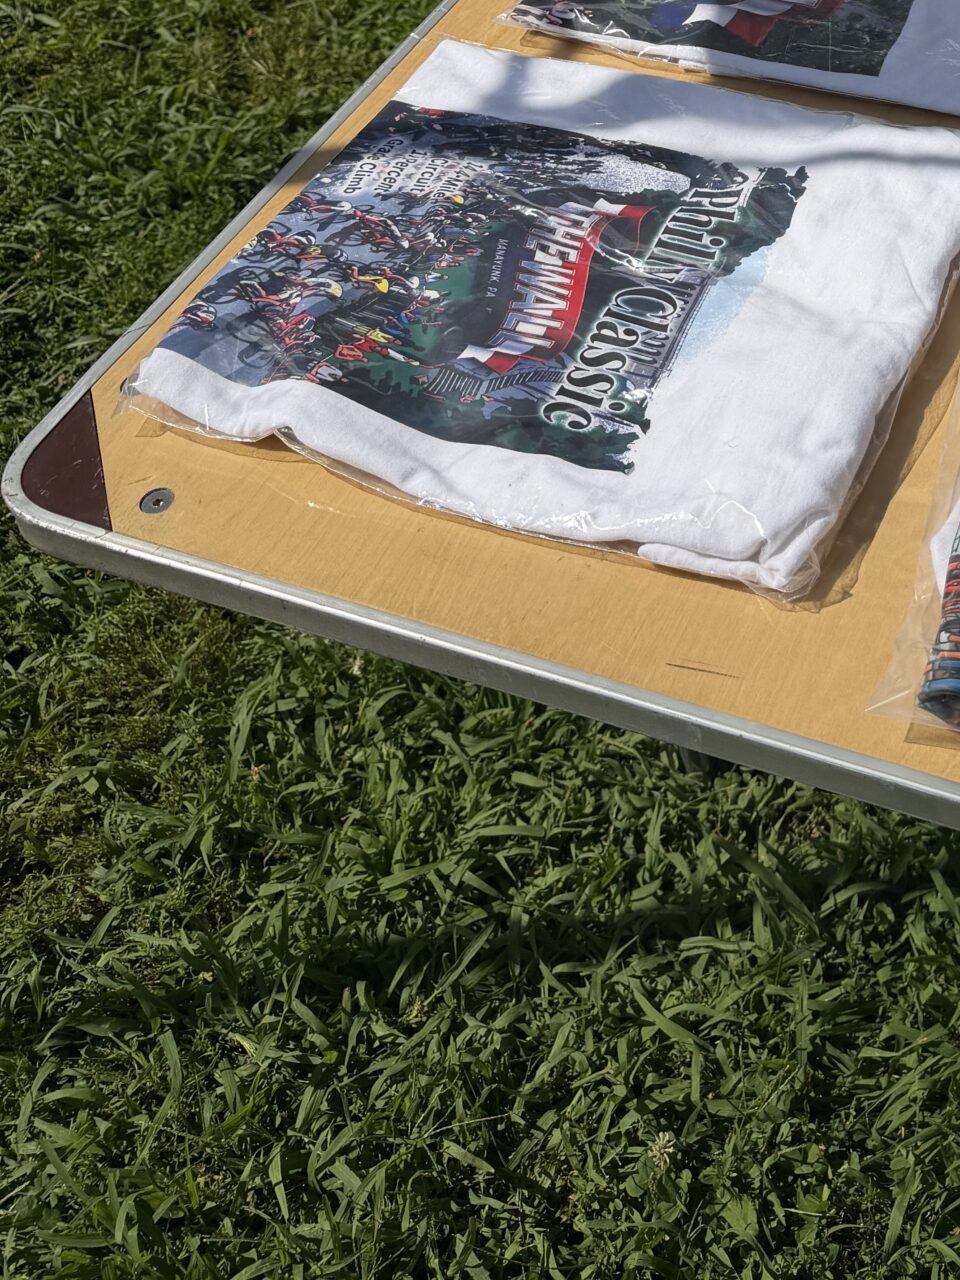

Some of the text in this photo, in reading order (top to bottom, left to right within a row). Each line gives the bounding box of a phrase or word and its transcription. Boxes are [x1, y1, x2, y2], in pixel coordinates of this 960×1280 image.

[343, 162, 377, 194] Climb
[374, 158, 418, 193] Percent
[410, 158, 449, 193] Circuit
[485, 238, 509, 298] MANAYUNK, PA
[488, 213, 599, 349] THE WALL
[543, 187, 744, 430] Philly Classic
